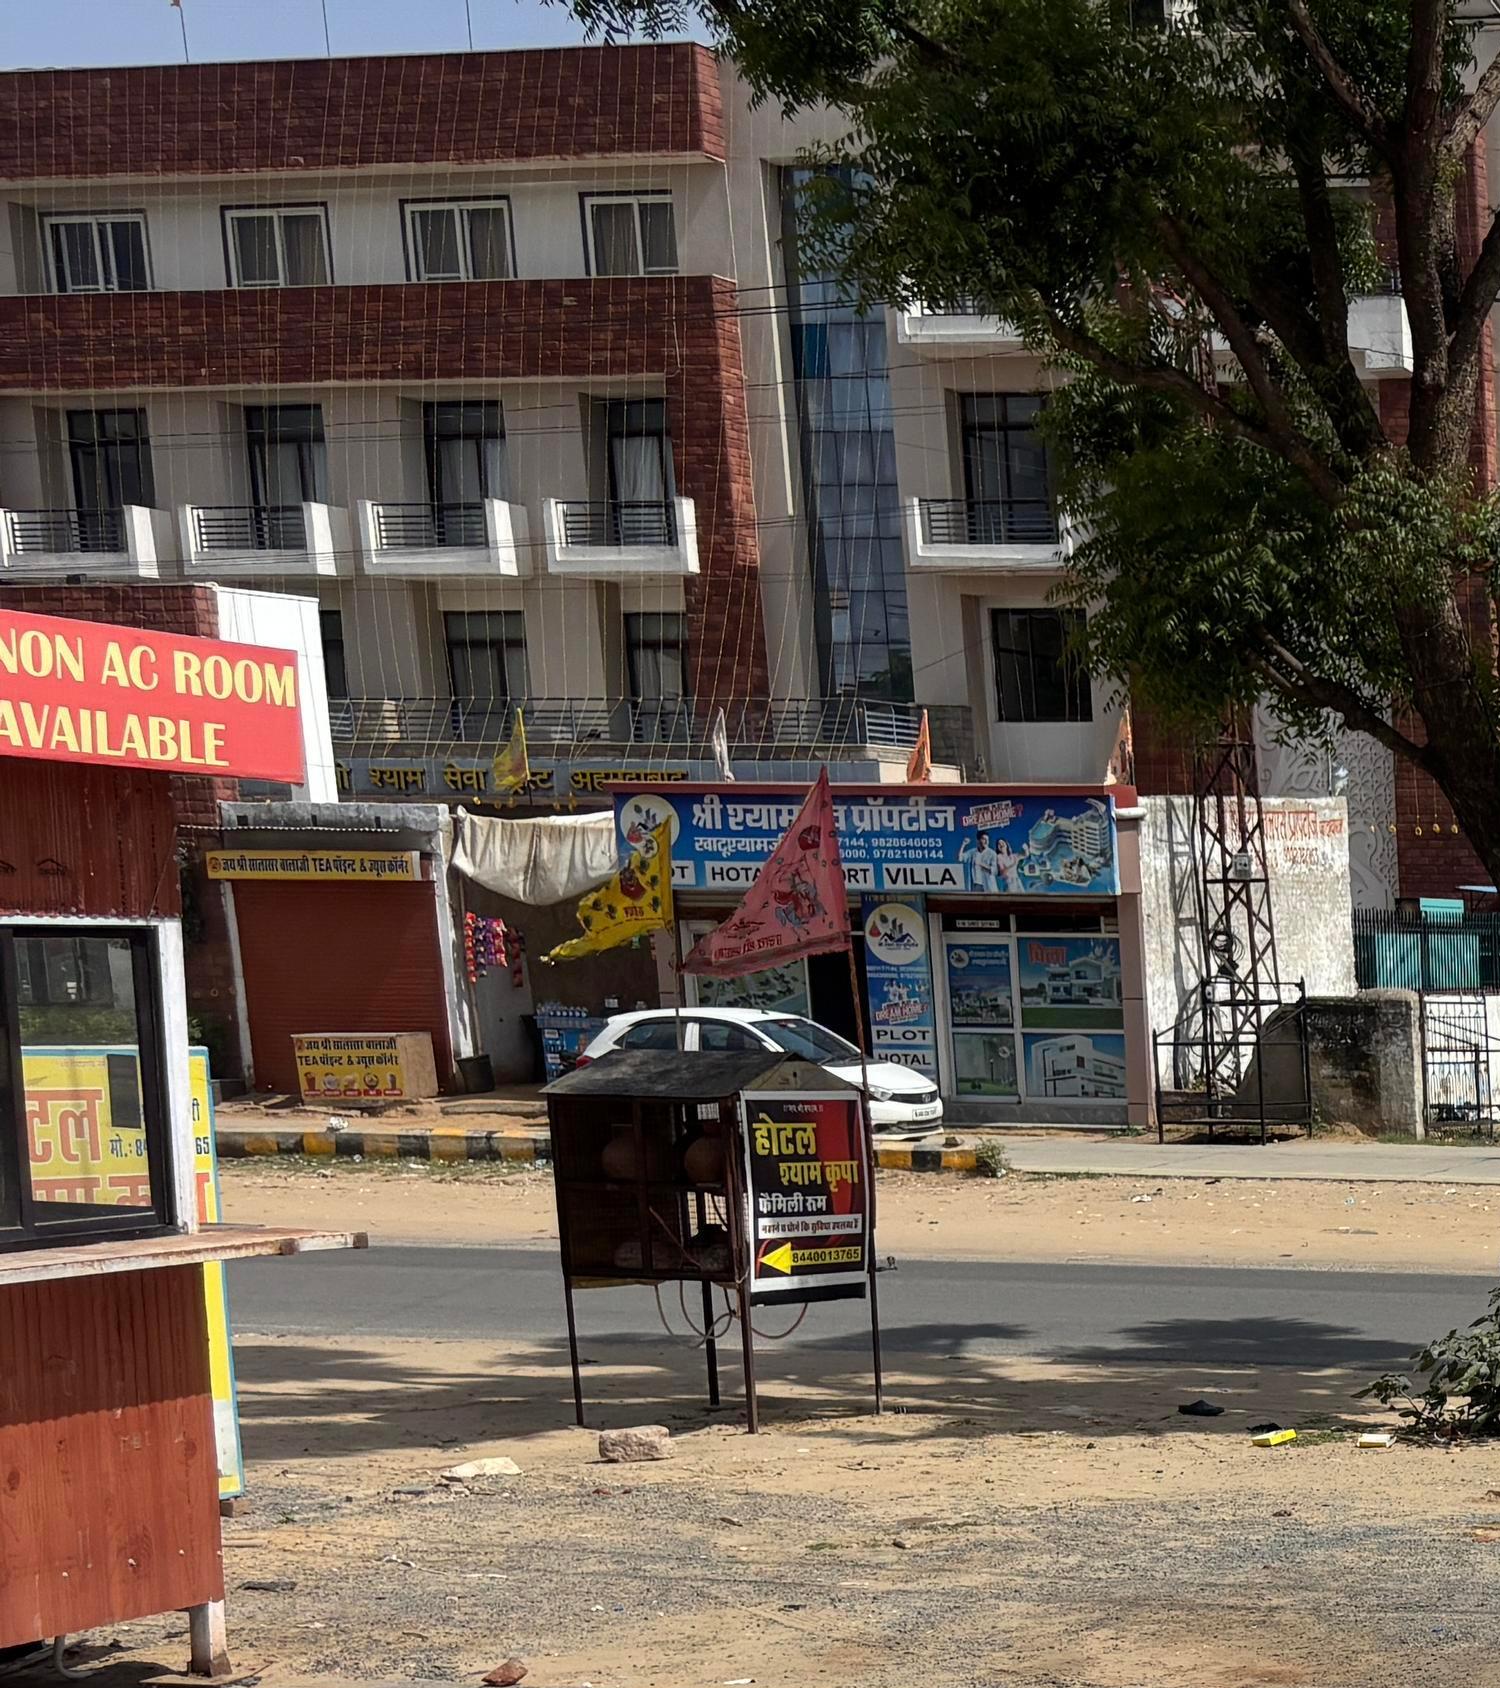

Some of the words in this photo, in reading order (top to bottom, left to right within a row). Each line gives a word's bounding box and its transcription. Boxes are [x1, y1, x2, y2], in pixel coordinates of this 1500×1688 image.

[0, 627, 85, 682] NON
[101, 641, 159, 691] AC
[173, 649, 296, 708] ROOM
[0, 700, 229, 767] AVAILABLE
[369, 766, 427, 791] श्याम
[444, 763, 487, 791] सेवा
[692, 794, 722, 831] श्री
[312, 858, 332, 873] TEA
[360, 858, 367, 873] &
[712, 867, 763, 882] HOTA
[885, 867, 957, 886] VILLA
[876, 1030, 931, 1042] PLOT
[299, 1055, 319, 1067] TEA
[347, 1055, 354, 1067] &
[878, 1053, 932, 1066] HOTAL
[25, 1089, 103, 1164] टल
[752, 1112, 817, 1157] होटल
[779, 1161, 822, 1187] श्याम
[823, 1160, 859, 1192] कृपा
[758, 1192, 804, 1215] फैमिली
[805, 1195, 827, 1212] रूम
[792, 1247, 859, 1264] 8440013765
